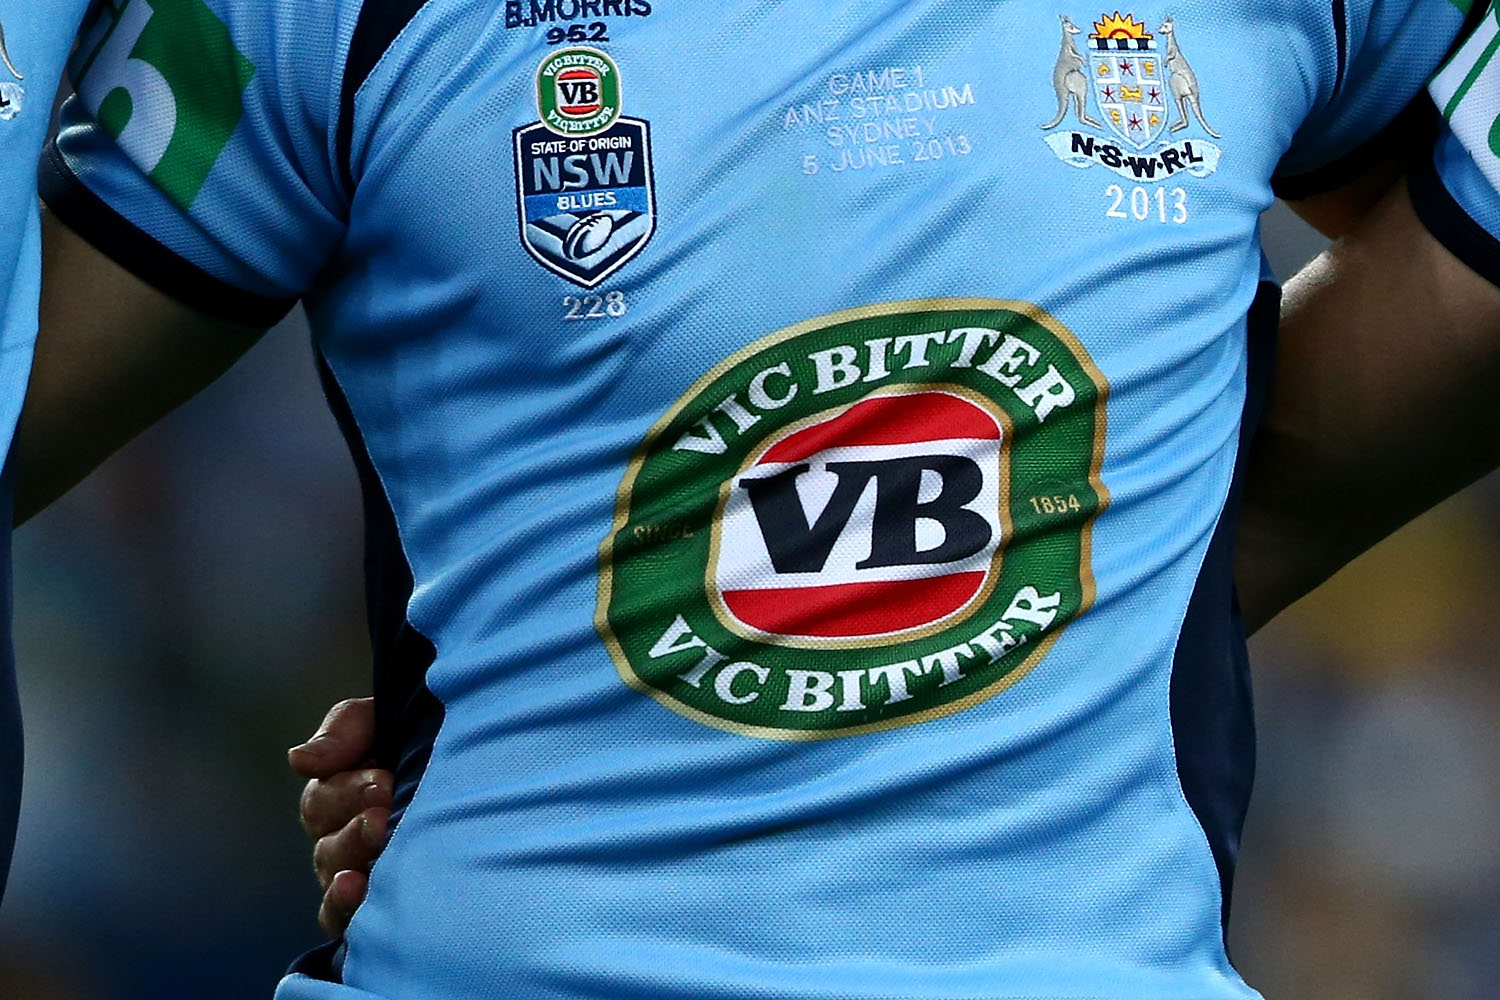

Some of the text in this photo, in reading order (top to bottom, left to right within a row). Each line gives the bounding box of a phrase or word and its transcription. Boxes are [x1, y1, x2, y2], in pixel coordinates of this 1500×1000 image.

[546, 21, 610, 45] 952
[558, 82, 598, 104] VB
[829, 65, 925, 95] GAME 1
[784, 83, 976, 130] ANZ STADIUM
[531, 136, 632, 155] STATE OF ORIGIN
[827, 115, 937, 147] SYDNEY
[803, 134, 972, 175] 5 JUNE 2013
[533, 151, 634, 191] NSW
[557, 192, 617, 210] BLUES
[1105, 184, 1188, 224] 2013
[562, 290, 627, 320] 228
[672, 326, 1077, 457] VIC BITTER
[738, 454, 993, 574] VB
[1029, 494, 1081, 514] 1854
[648, 585, 1063, 714] VIC BITTER
